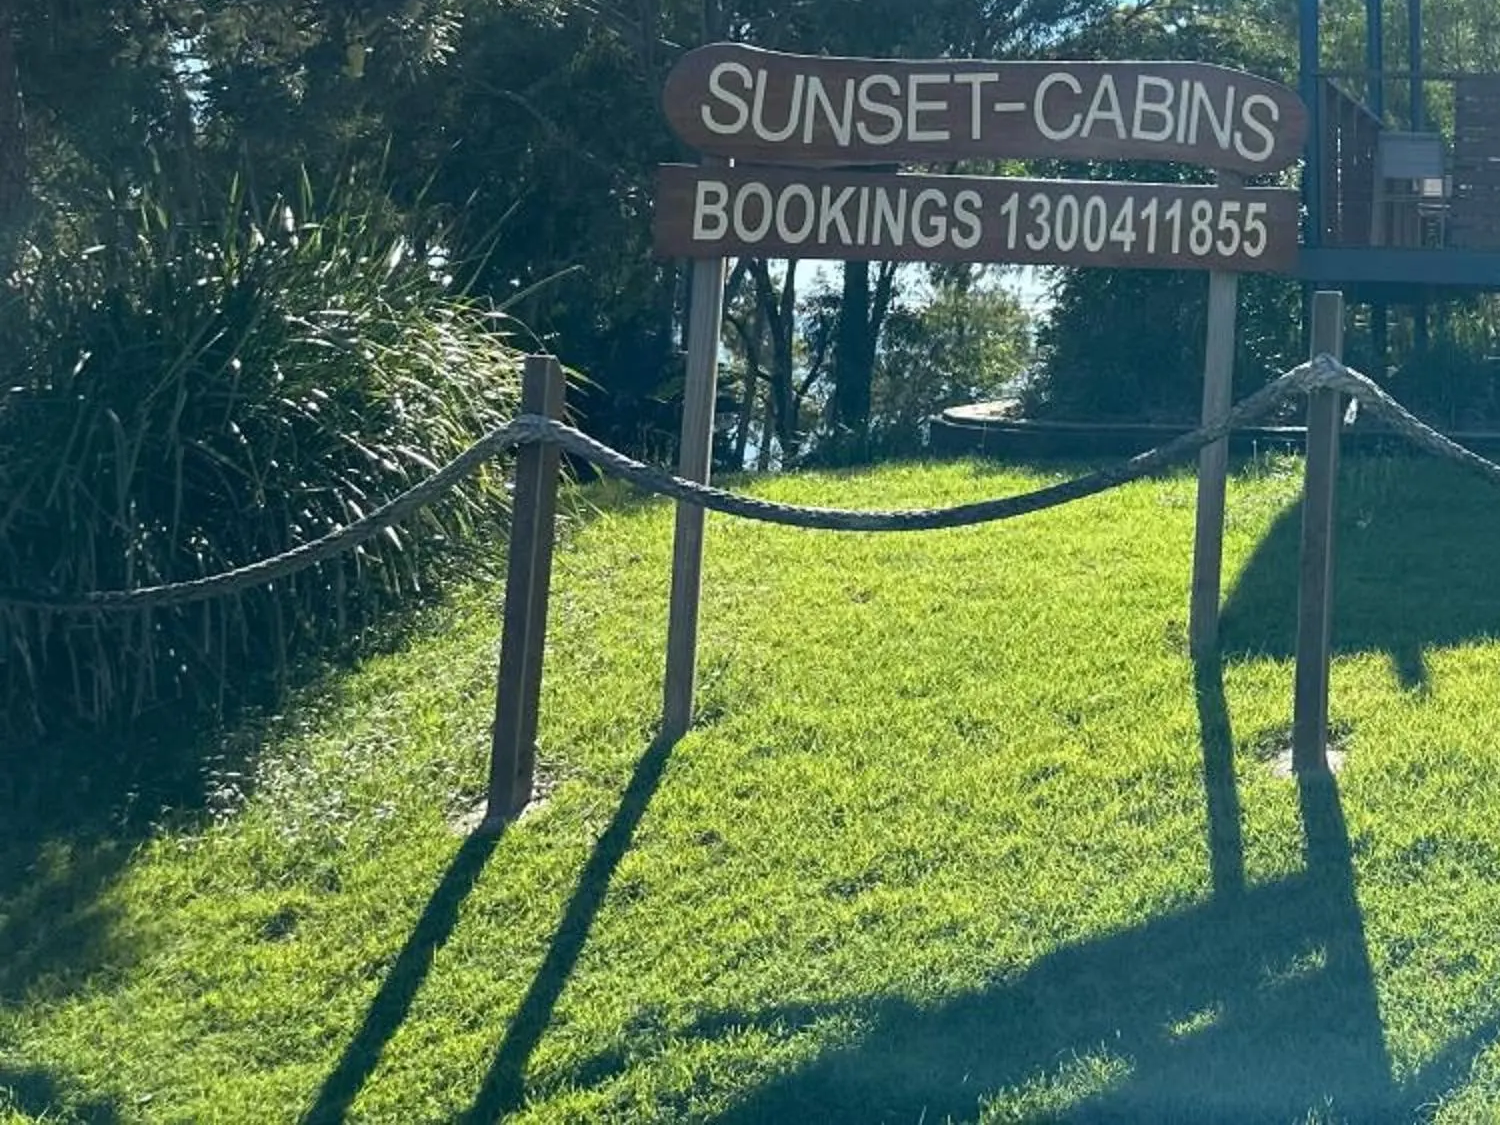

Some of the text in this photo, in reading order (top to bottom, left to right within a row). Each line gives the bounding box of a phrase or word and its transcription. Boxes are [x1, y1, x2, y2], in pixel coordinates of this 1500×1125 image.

[700, 62, 1280, 162] SUNSET-CABINS
[692, 180, 1269, 257] BOOKINGS 1300411855
